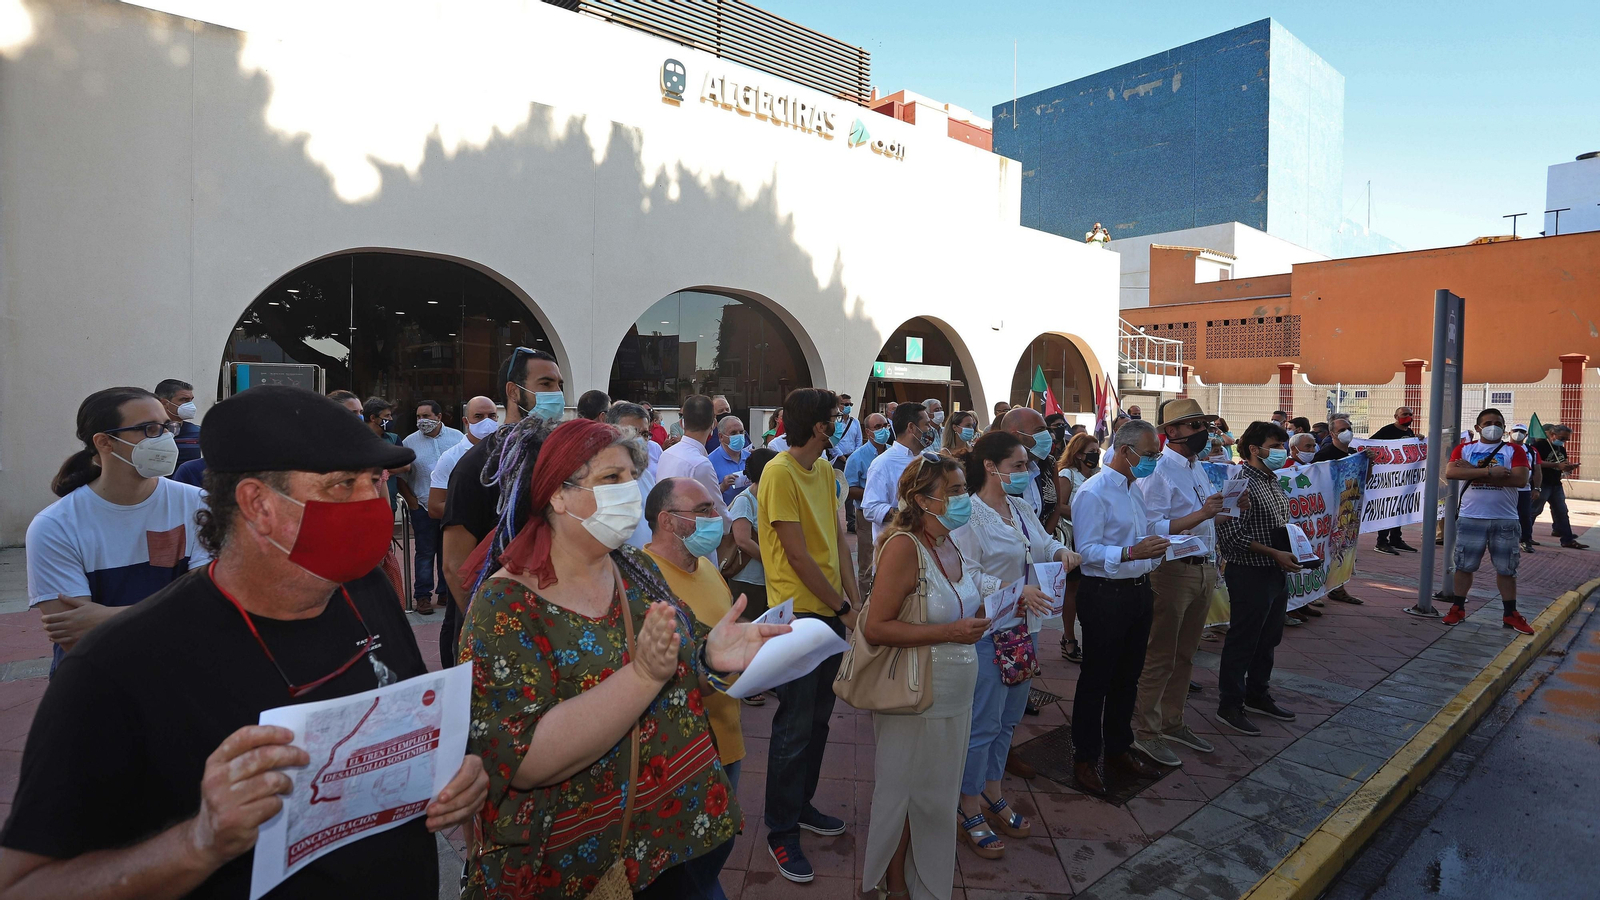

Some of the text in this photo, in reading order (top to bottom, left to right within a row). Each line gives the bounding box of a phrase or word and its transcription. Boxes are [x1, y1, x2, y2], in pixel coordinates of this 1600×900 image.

[700, 71, 836, 141] ALGECIRAS
[1403, 443, 1428, 464] EMPLE
[1289, 493, 1326, 519] ORMA
[1361, 487, 1421, 522] PRIVATIZACIÓN
[325, 742, 433, 781] DESARROLLO SOSTENIBLE
[348, 757, 360, 766] EL
[362, 750, 385, 764] TREN
[387, 745, 397, 755] ES
[398, 735, 428, 752] EMPLEO
[291, 813, 380, 855] CONCENTRACIÓN
